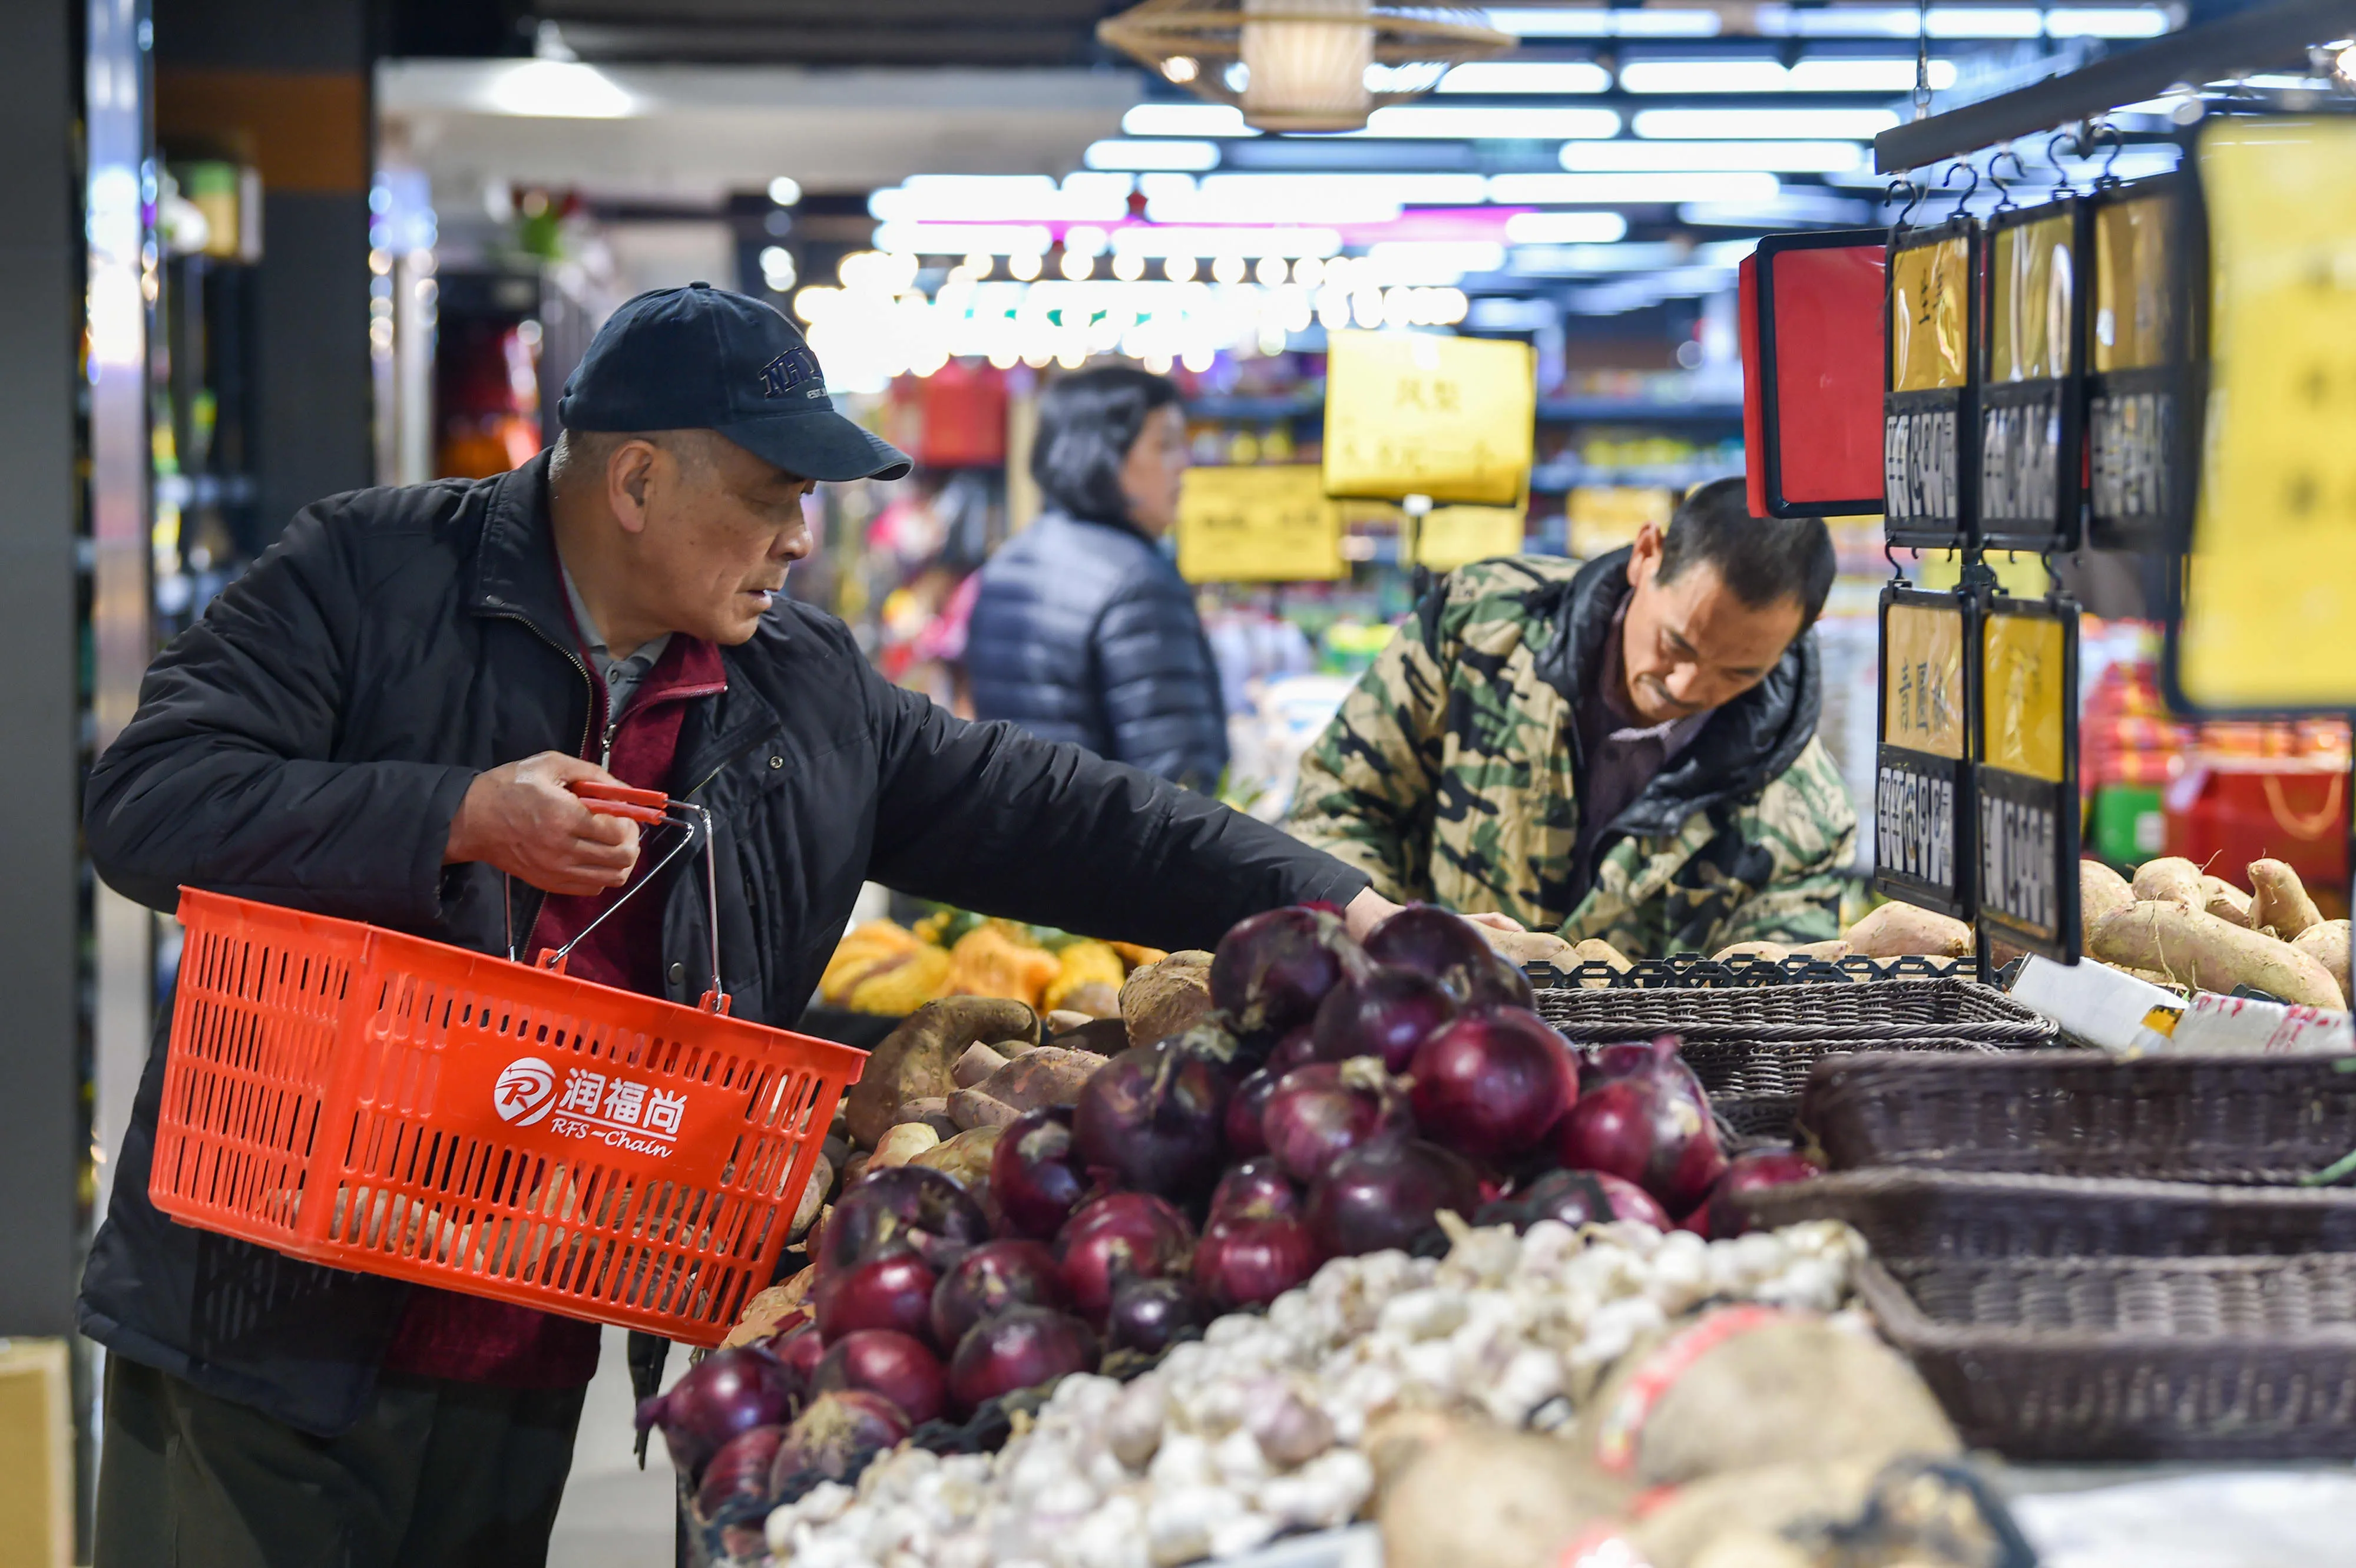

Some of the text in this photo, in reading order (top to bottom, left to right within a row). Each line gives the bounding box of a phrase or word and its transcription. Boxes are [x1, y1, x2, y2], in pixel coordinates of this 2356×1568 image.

[558, 1066, 688, 1135] 润福尚
[550, 1117, 673, 1159] RFS-Chain
